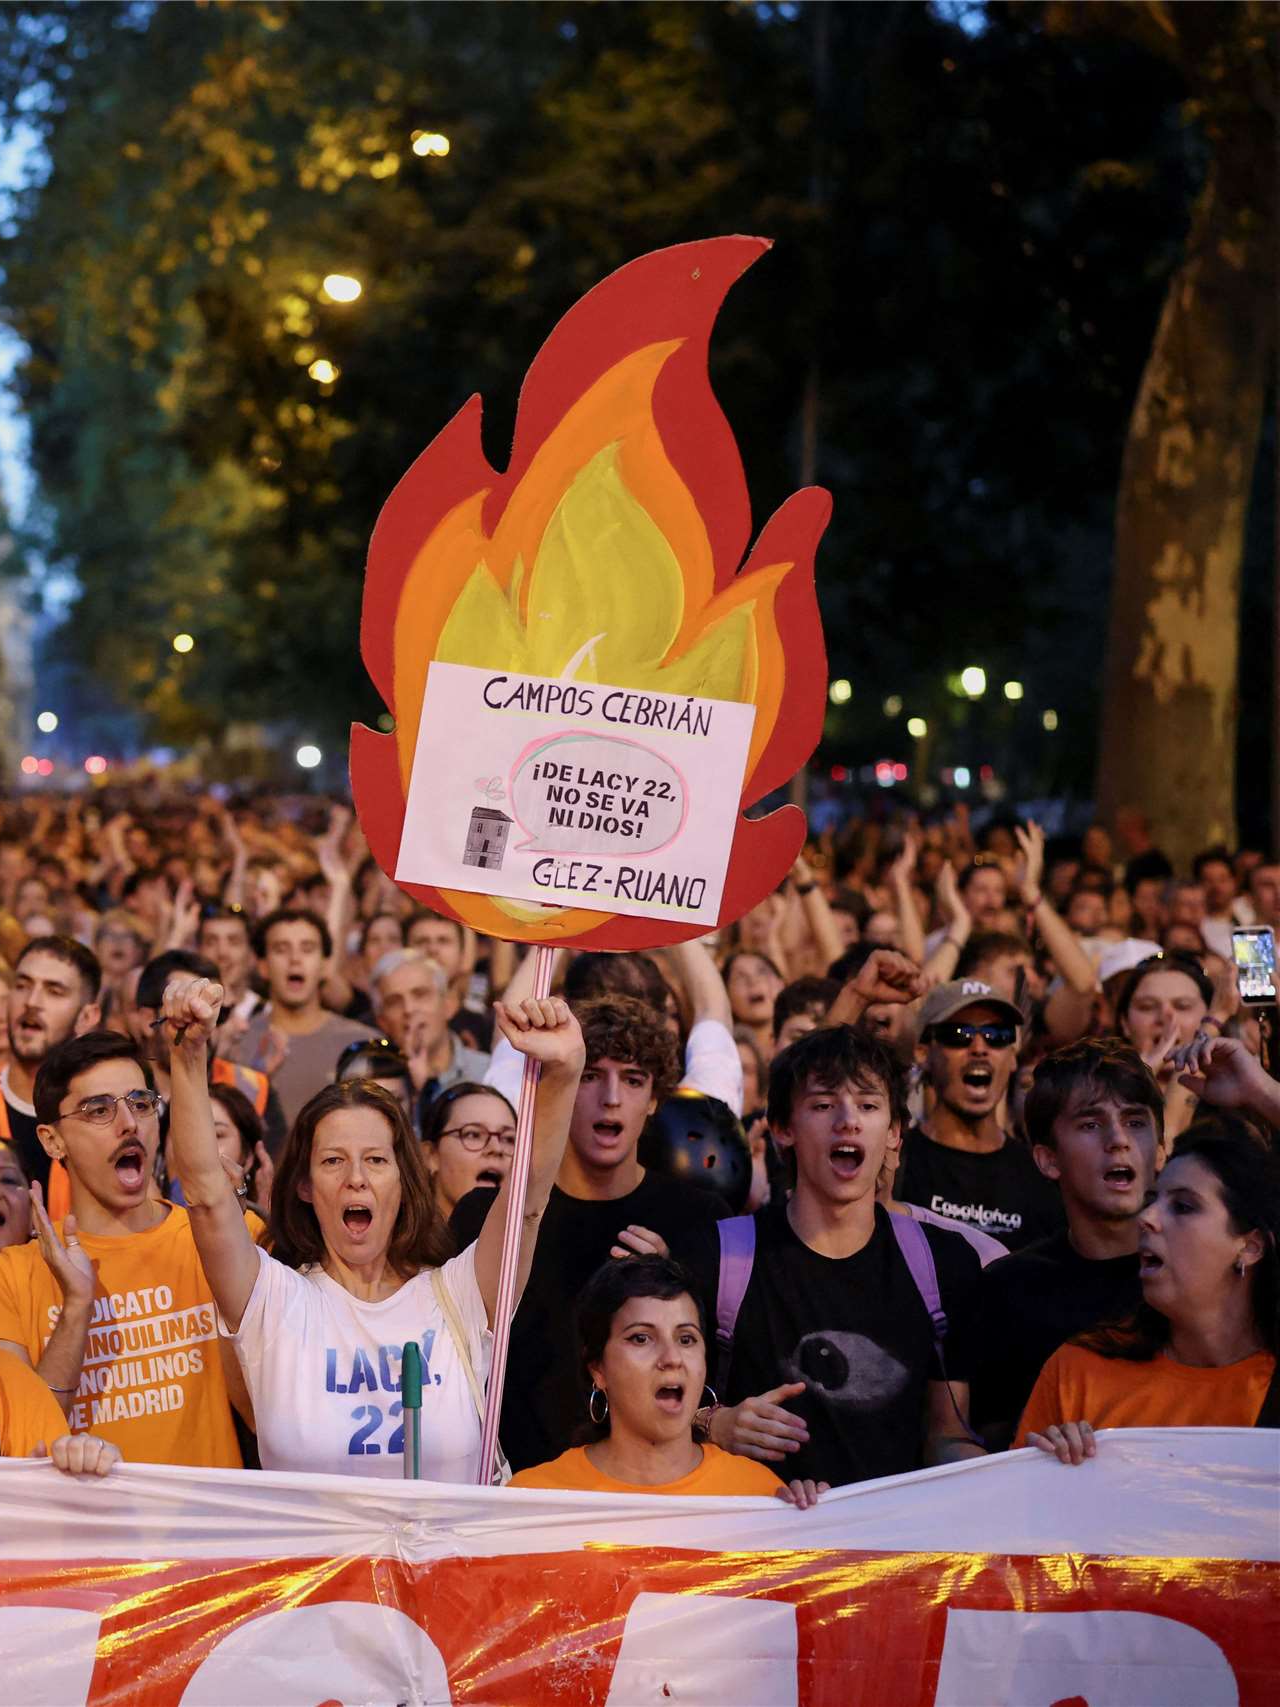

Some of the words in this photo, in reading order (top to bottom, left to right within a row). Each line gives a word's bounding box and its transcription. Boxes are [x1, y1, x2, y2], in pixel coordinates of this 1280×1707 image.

[483, 676, 595, 716] CAMPOS
[601, 691, 713, 737] CEBRIÁN
[532, 761, 574, 783] ¡DE
[577, 767, 639, 793] LACY
[642, 779, 677, 803] 22,
[546, 784, 581, 805] NO
[585, 791, 615, 812] SE
[621, 797, 650, 818] VA
[548, 807, 574, 828] NI
[578, 811, 644, 839] DIOS!
[961, 981, 991, 995] NY
[47, 1285, 173, 1330] SDICATO
[91, 1384, 185, 1425] MADRID
